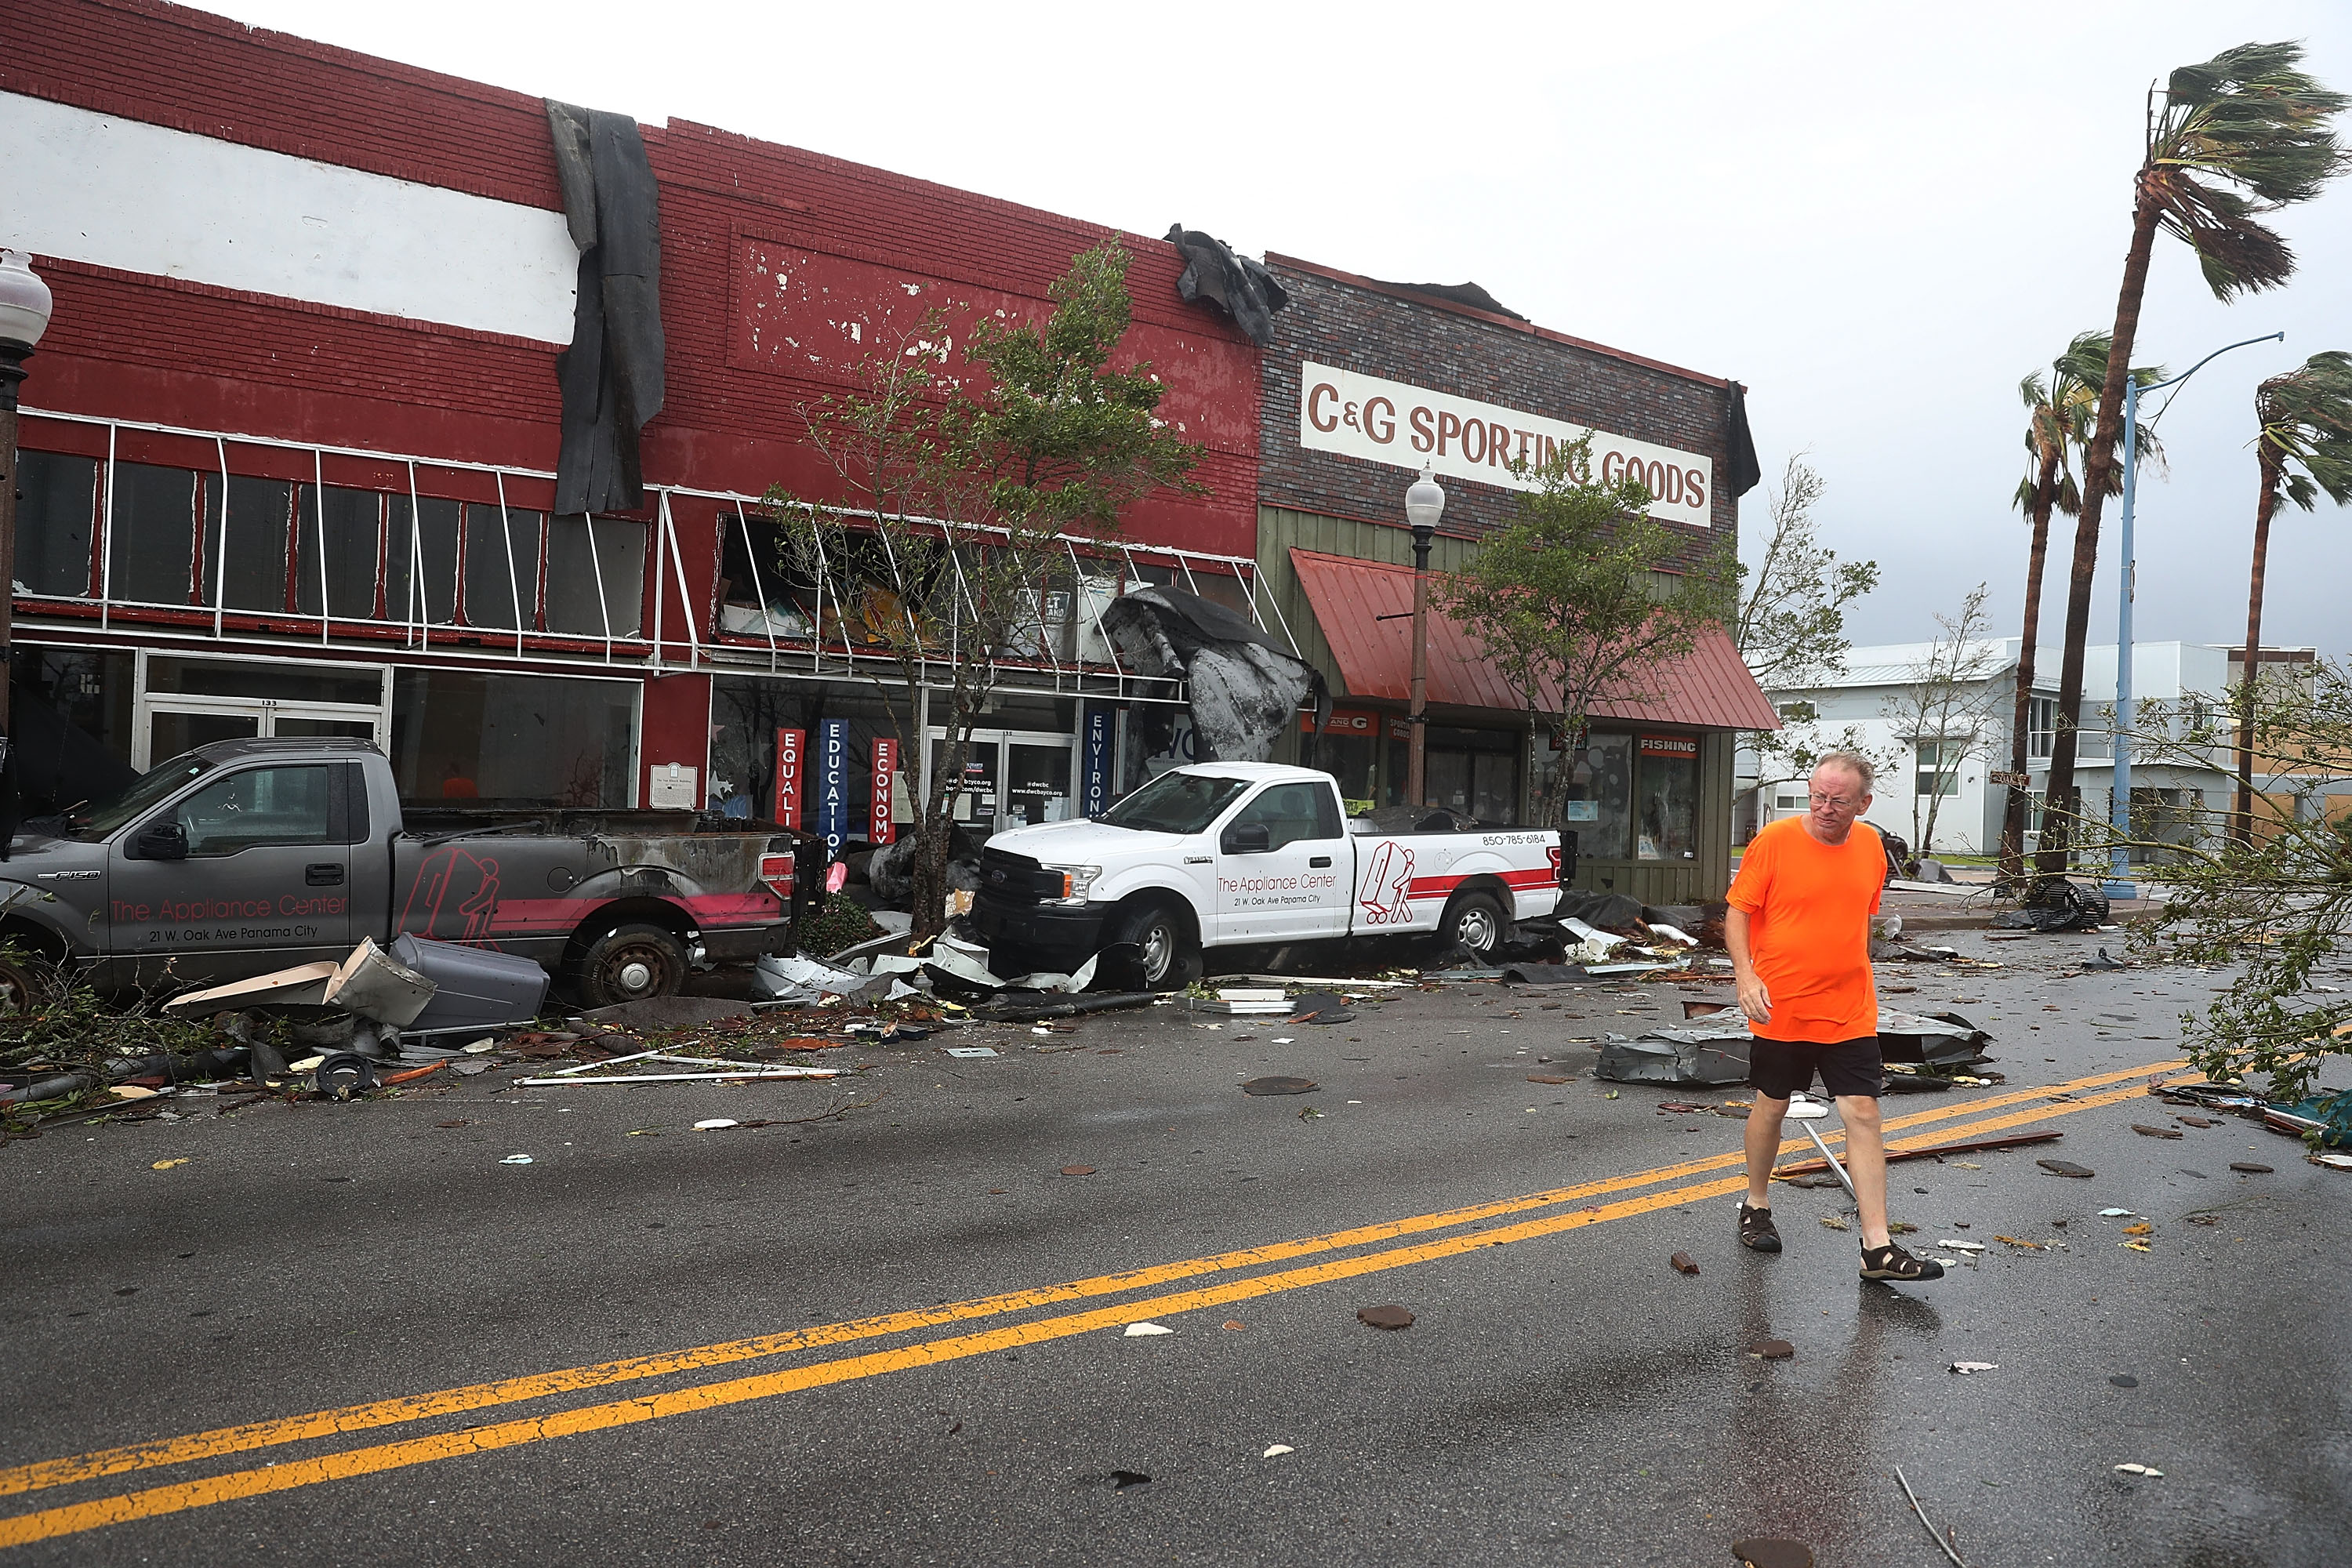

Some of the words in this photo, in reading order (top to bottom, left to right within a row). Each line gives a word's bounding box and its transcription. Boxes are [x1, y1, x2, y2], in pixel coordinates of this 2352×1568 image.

[1308, 383, 1396, 445] C&G
[1602, 451, 1704, 508] GOODS
[1352, 717, 1367, 729] G
[1640, 739, 1696, 752] FISHING
[1089, 714, 1102, 818] ENVIRON
[876, 743, 888, 844] ECONOMY
[1483, 834, 1545, 846] 850-785-6184
[54, 870, 101, 880] F-150
[1218, 877, 1237, 892] The
[1240, 877, 1297, 894] Appliance
[1301, 873, 1337, 889] Center
[1251, 896, 1265, 906] Oak
[1267, 896, 1279, 905] Ave
[1280, 896, 1307, 905] Panama
[1308, 894, 1321, 903] City
[112, 901, 151, 922] The
[158, 898, 270, 924] Appliance
[278, 895, 347, 916] Center
[149, 931, 161, 942] 21
[165, 930, 179, 942] W.
[183, 929, 209, 941] Oak
[215, 928, 237, 939] Ave
[241, 927, 291, 938] Panama
[294, 925, 318, 938] City
